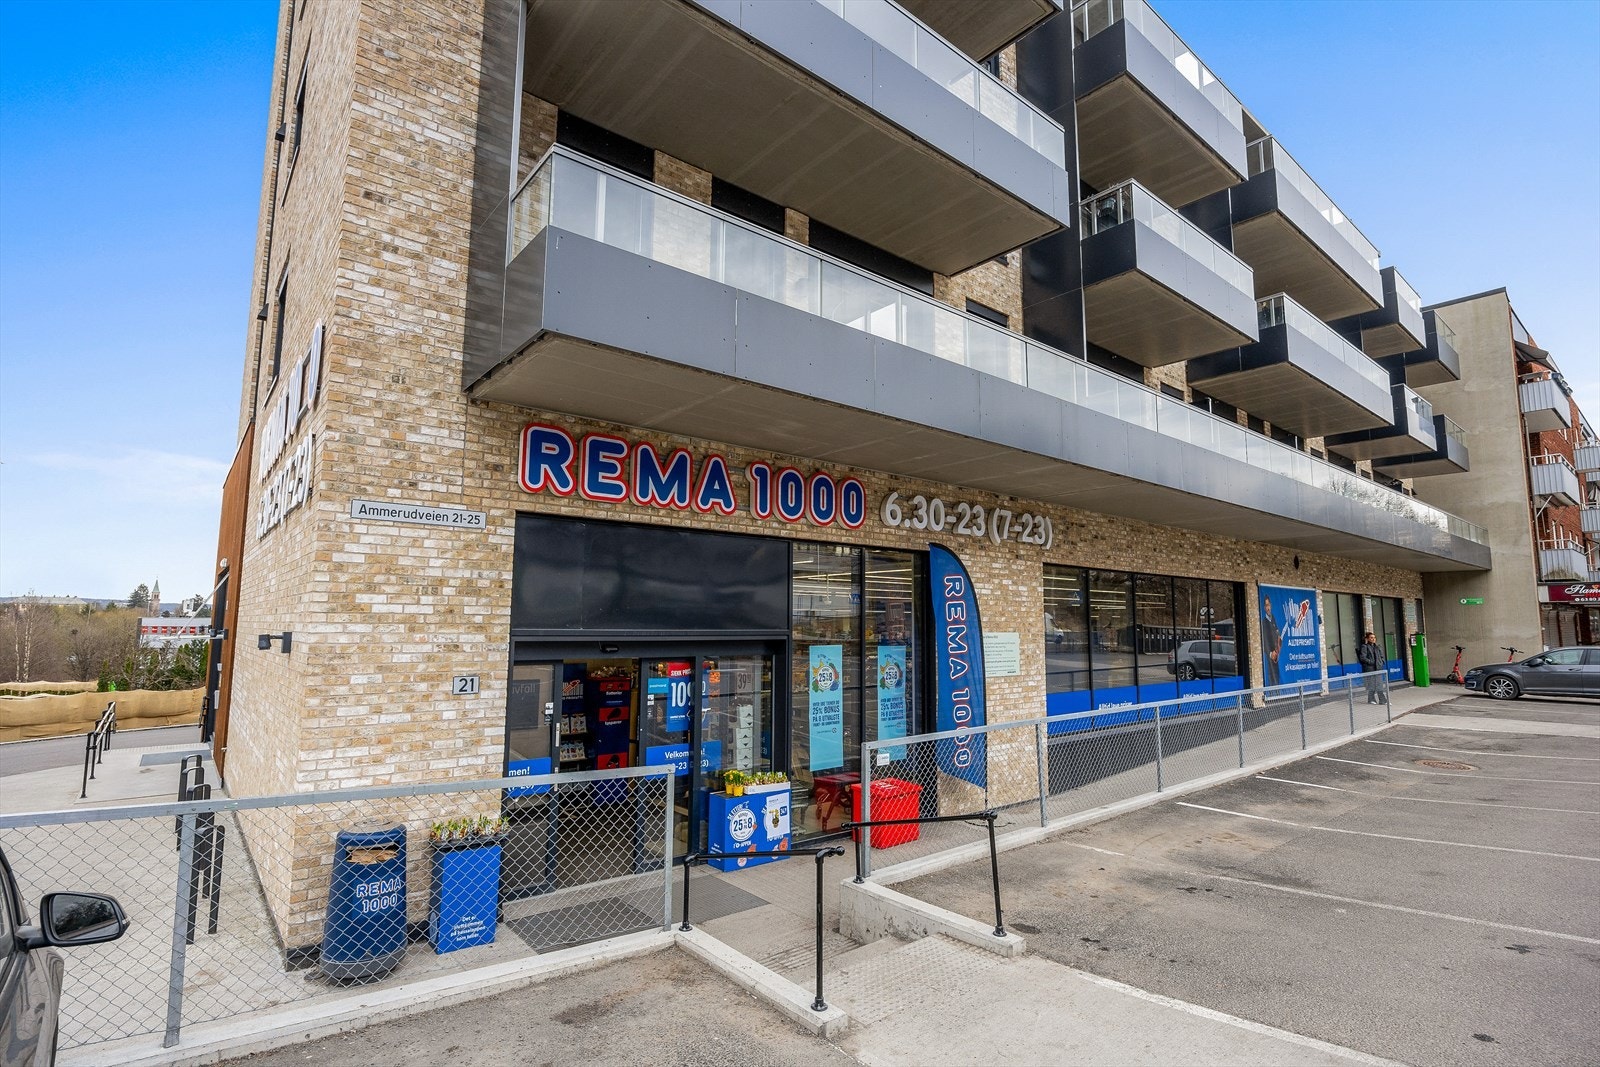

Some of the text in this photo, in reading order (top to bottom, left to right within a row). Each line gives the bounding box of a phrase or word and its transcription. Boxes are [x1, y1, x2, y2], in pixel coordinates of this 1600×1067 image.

[518, 422, 867, 530] REMA 1000
[358, 503, 481, 525] Ammerudveien 21-25
[880, 491, 1053, 550] 6.30-23 (7-23)
[944, 575, 968, 680] REMA
[459, 678, 474, 692] 21
[812, 705, 840, 715] 25% BONUS
[733, 819, 743, 832] 25
[747, 817, 753, 829] 8
[356, 876, 401, 913] REMA 1000
